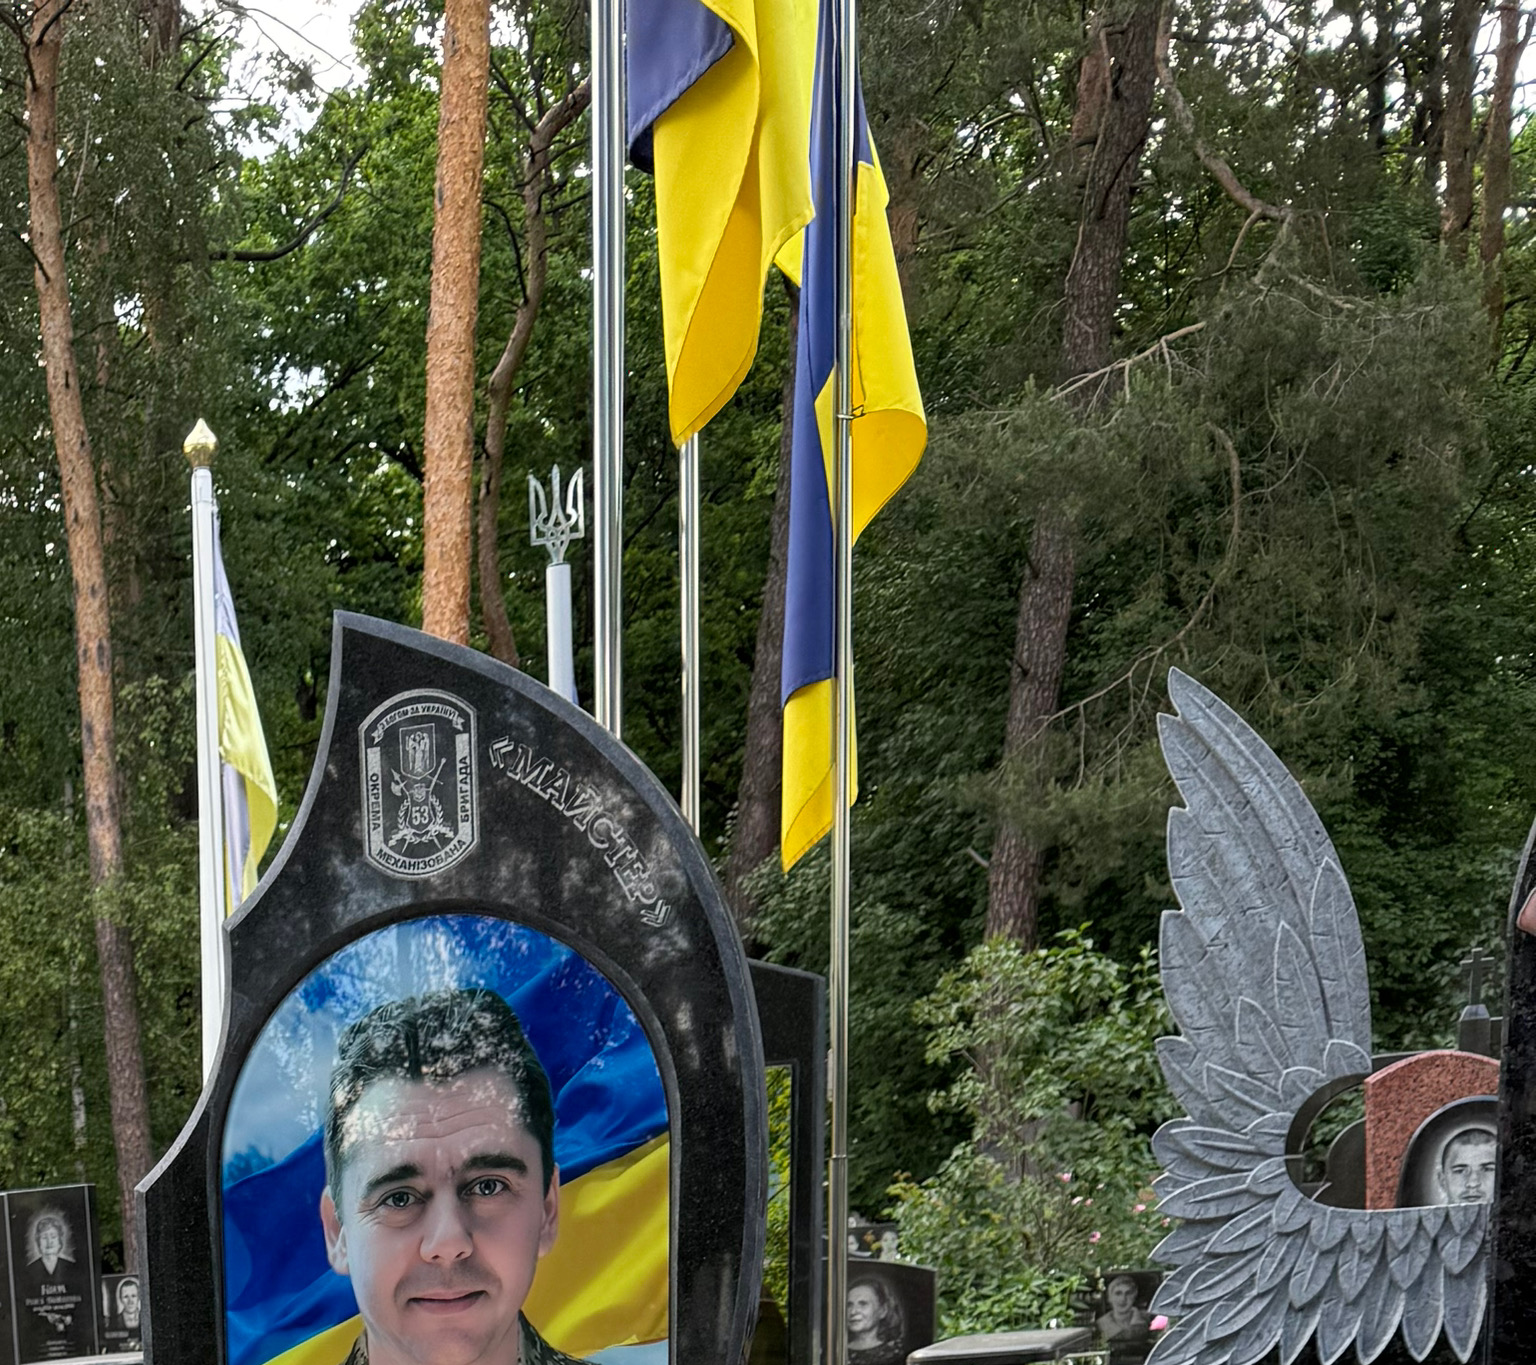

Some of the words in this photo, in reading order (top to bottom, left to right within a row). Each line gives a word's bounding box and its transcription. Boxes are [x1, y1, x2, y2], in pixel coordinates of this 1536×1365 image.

[369, 772, 382, 833] ОКРЕМА
[411, 804, 430, 826] 53
[457, 754, 471, 824] БРИГАДА
[375, 837, 468, 872] МЕХАНІЗОВАНА
[488, 735, 672, 928] «МАЙСТЕР»
